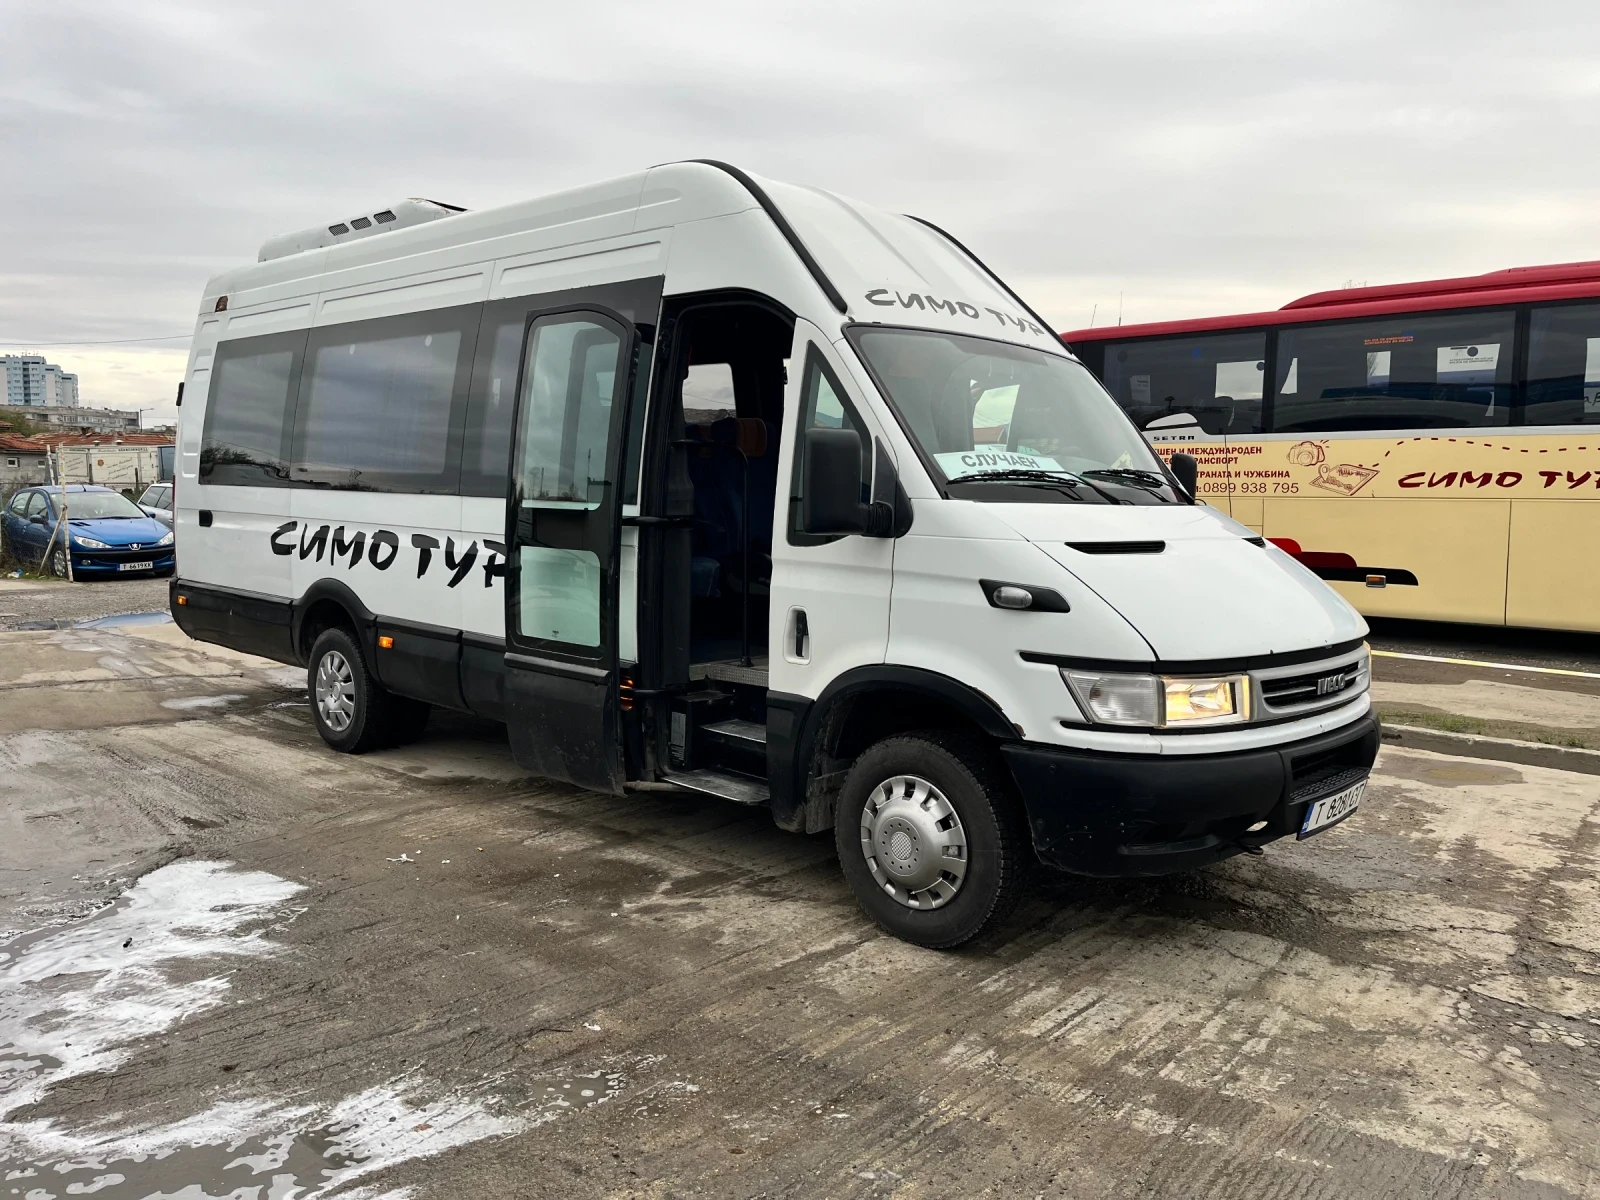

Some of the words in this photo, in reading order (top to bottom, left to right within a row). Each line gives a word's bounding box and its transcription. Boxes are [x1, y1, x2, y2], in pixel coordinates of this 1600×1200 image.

[864, 288, 980, 320] СИМО
[1187, 446, 1262, 456] МЕЖДУНАРОДЕН
[960, 453, 1041, 469] СЛУЧАЕН
[1234, 470, 1241, 478] И
[1243, 470, 1290, 478] ЧУЖБИНА
[1397, 470, 1523, 489] СИМО
[1538, 470, 1600, 490] ТУ
[1203, 482, 1236, 494] 0899
[1241, 482, 1267, 493] 938
[1272, 482, 1299, 493] 795
[270, 520, 399, 571] СИМО
[1317, 673, 1346, 695] IVECO
